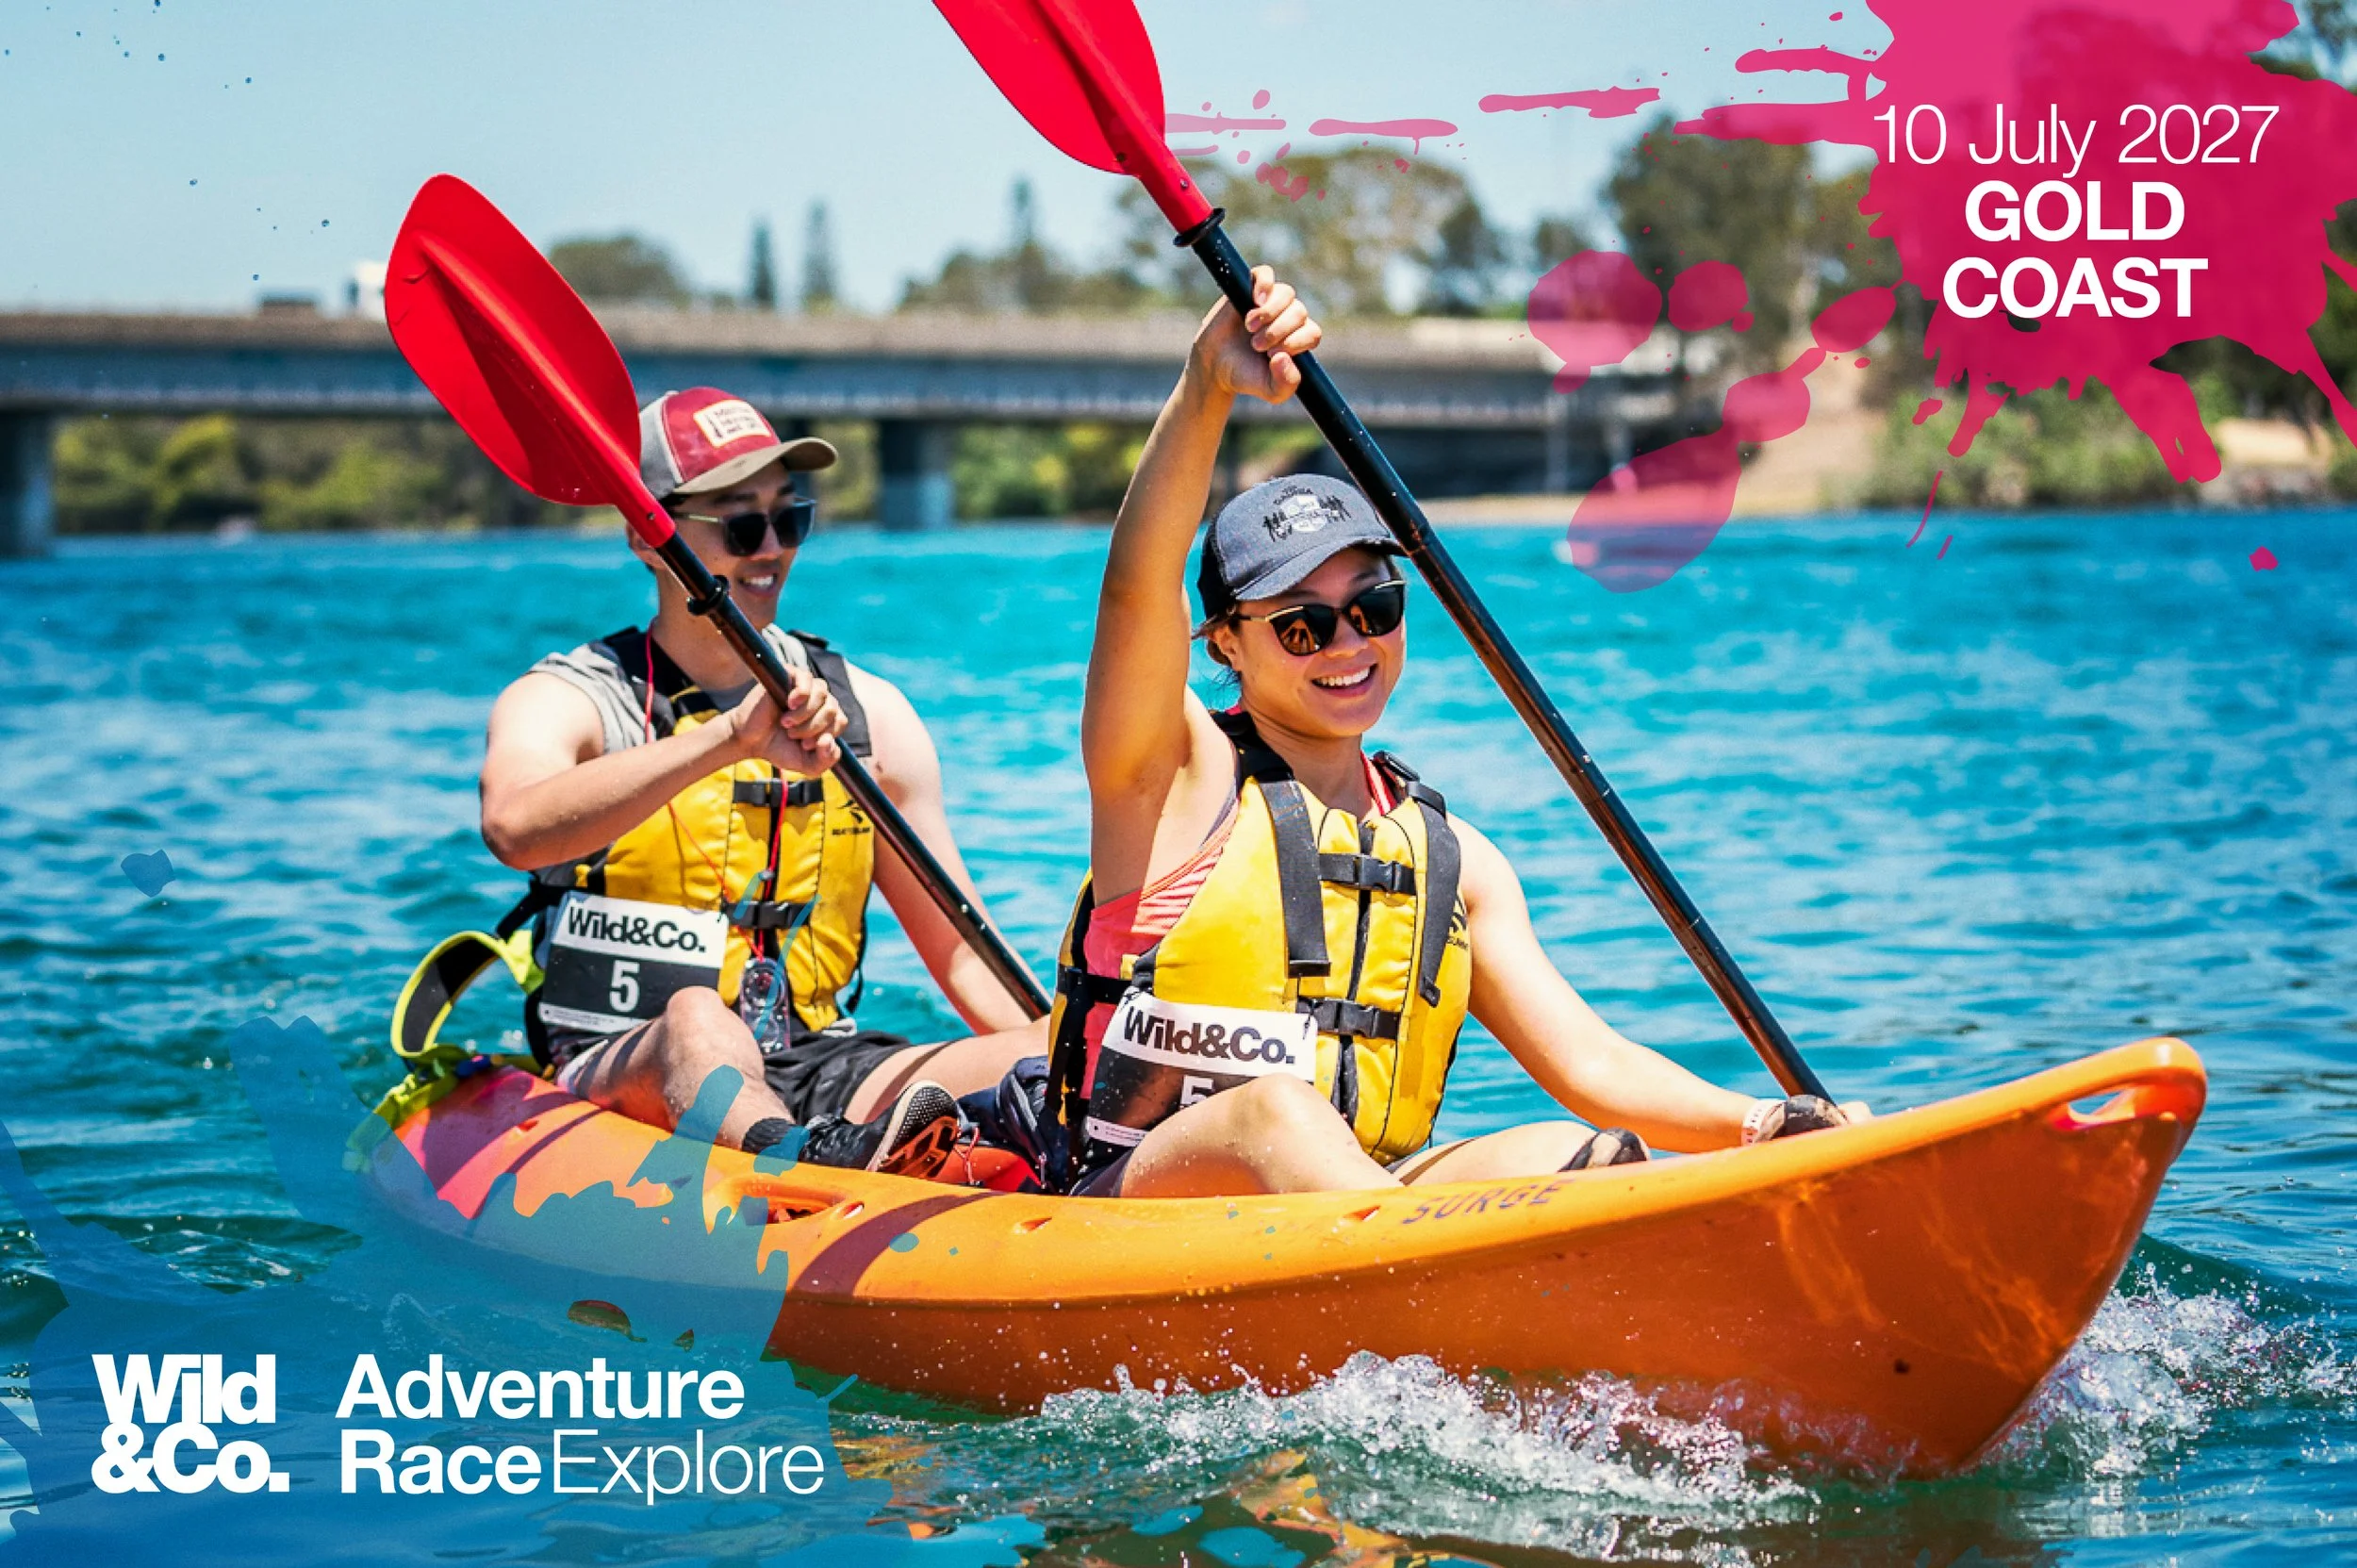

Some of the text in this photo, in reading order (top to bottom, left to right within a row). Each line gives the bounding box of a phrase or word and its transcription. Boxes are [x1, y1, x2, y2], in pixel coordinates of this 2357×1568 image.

[568, 905, 707, 953] Wild&Co.
[608, 959, 641, 1014] 5
[1123, 1005, 1296, 1065] Wild&Co.
[1400, 1179, 1575, 1225] SURGE
